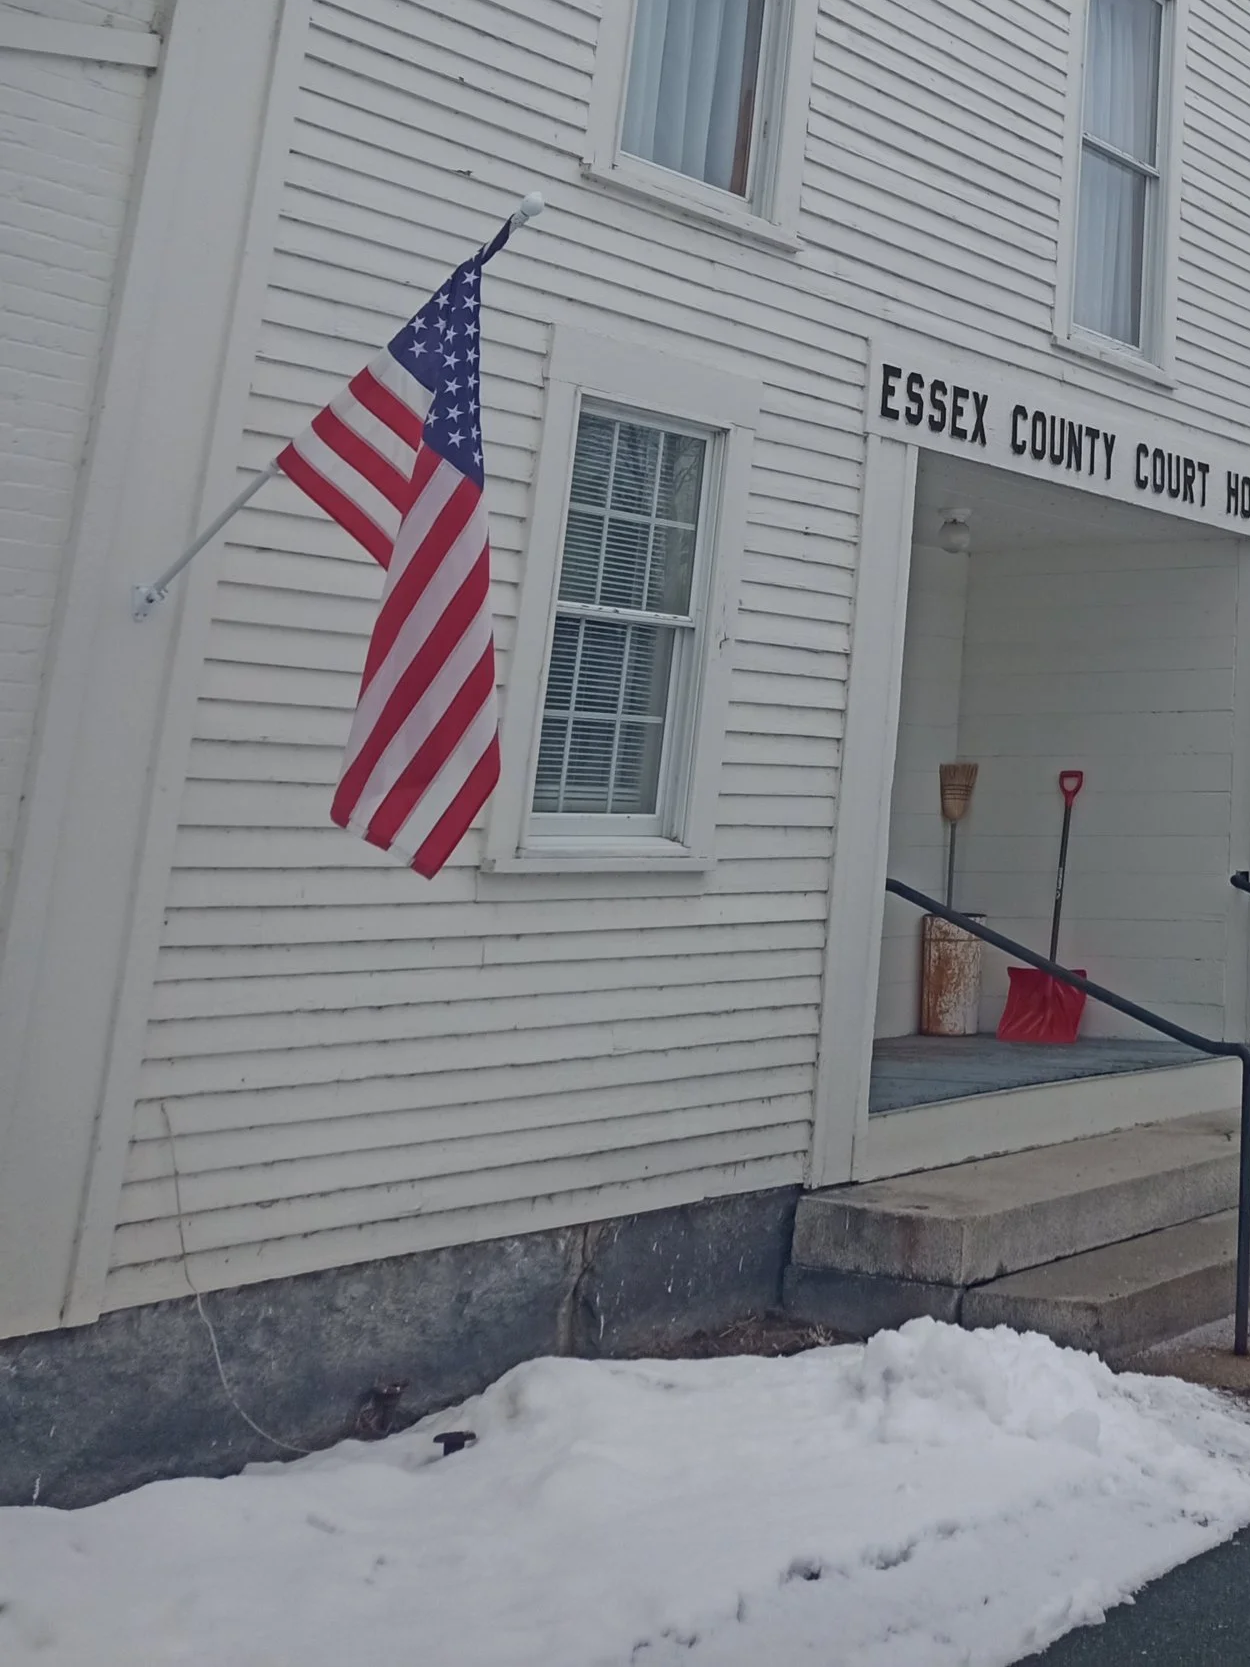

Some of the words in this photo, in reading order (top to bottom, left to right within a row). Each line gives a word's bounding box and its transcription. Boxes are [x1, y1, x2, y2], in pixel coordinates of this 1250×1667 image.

[880, 363, 988, 446] ESSEX
[1011, 404, 1116, 480] COUNTY
[1135, 442, 1210, 507] COURT
